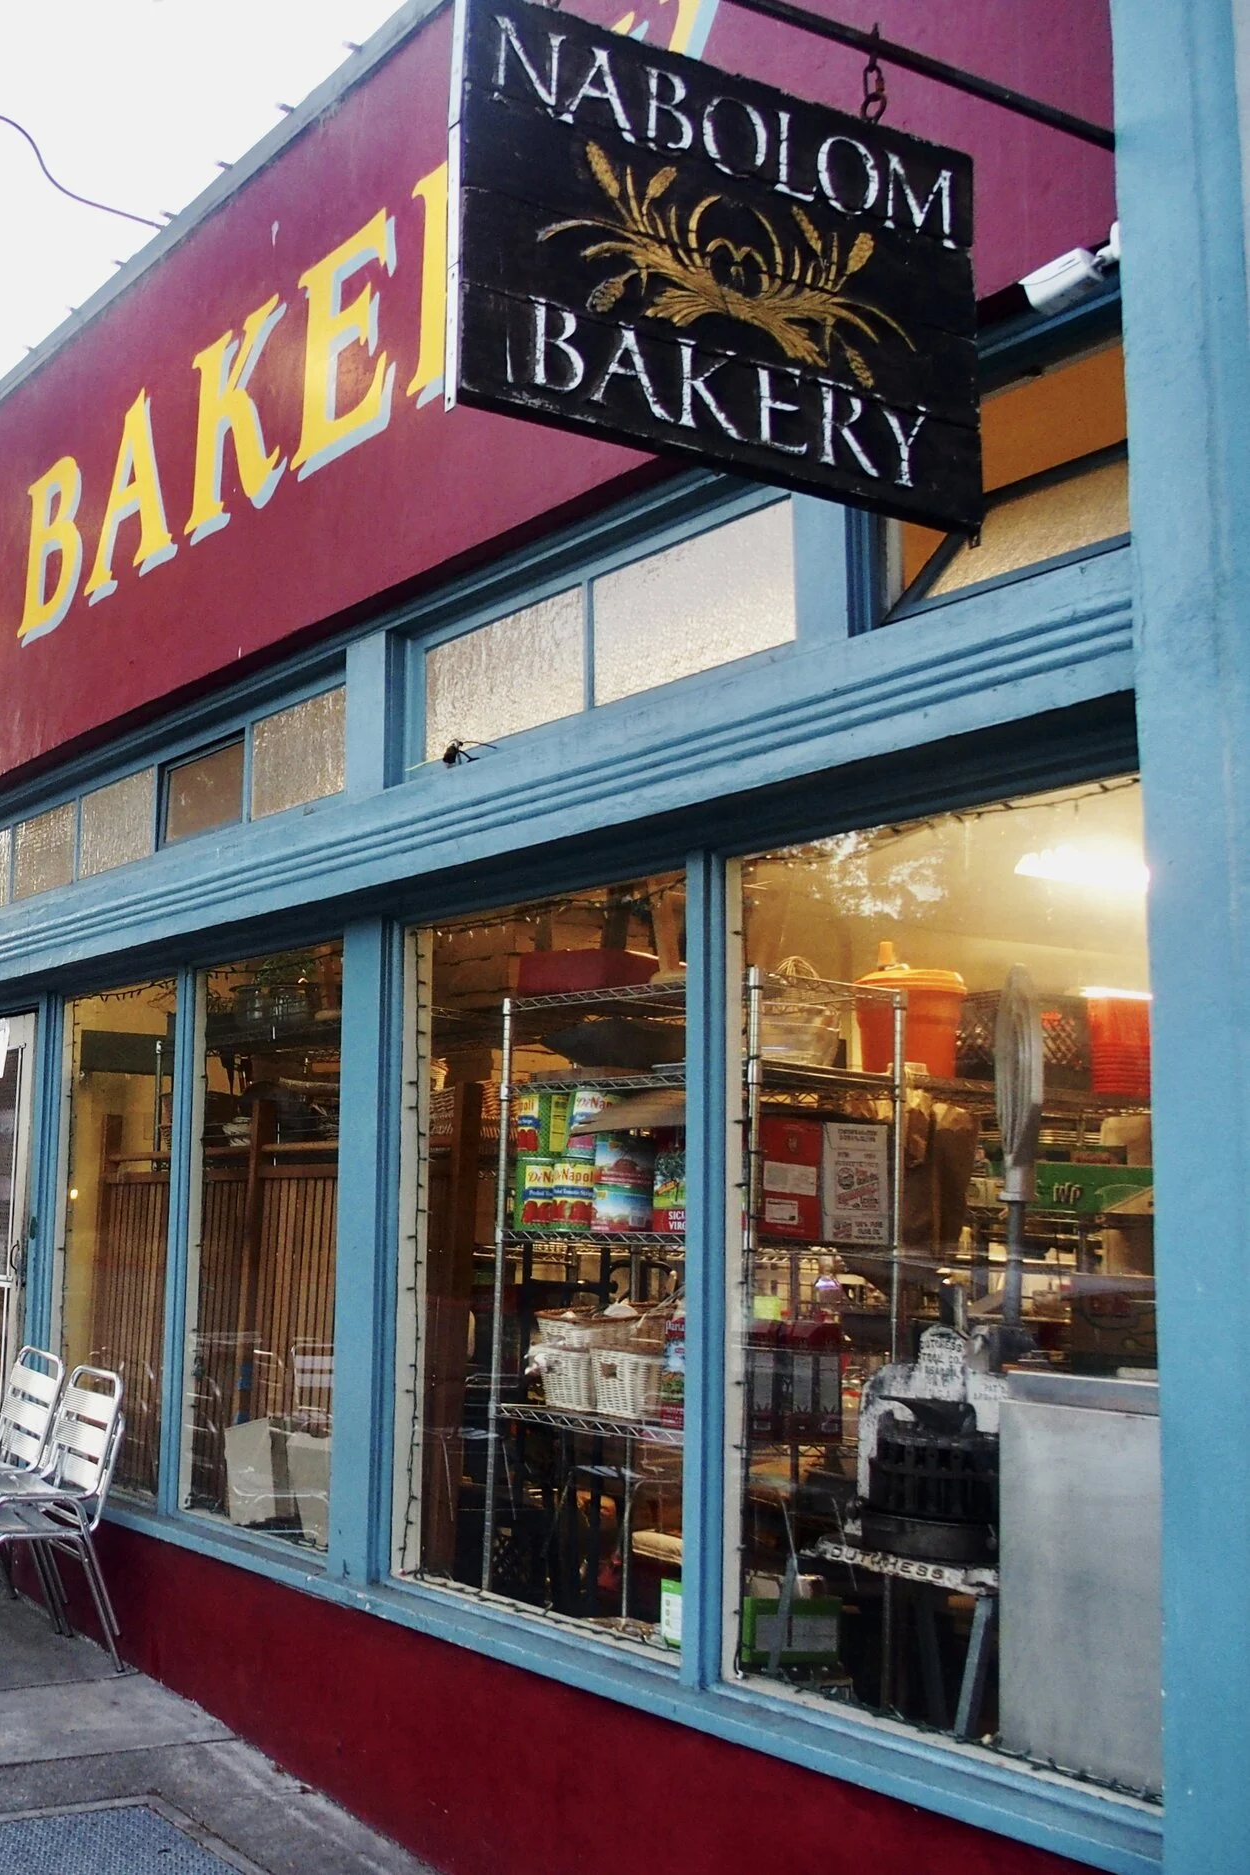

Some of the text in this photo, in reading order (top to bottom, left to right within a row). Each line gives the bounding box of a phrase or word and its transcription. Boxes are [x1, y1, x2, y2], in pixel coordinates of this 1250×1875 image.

[493, 15, 958, 249] NABOLOM
[17, 160, 448, 648] BAKE
[529, 296, 930, 488] BAKERY
